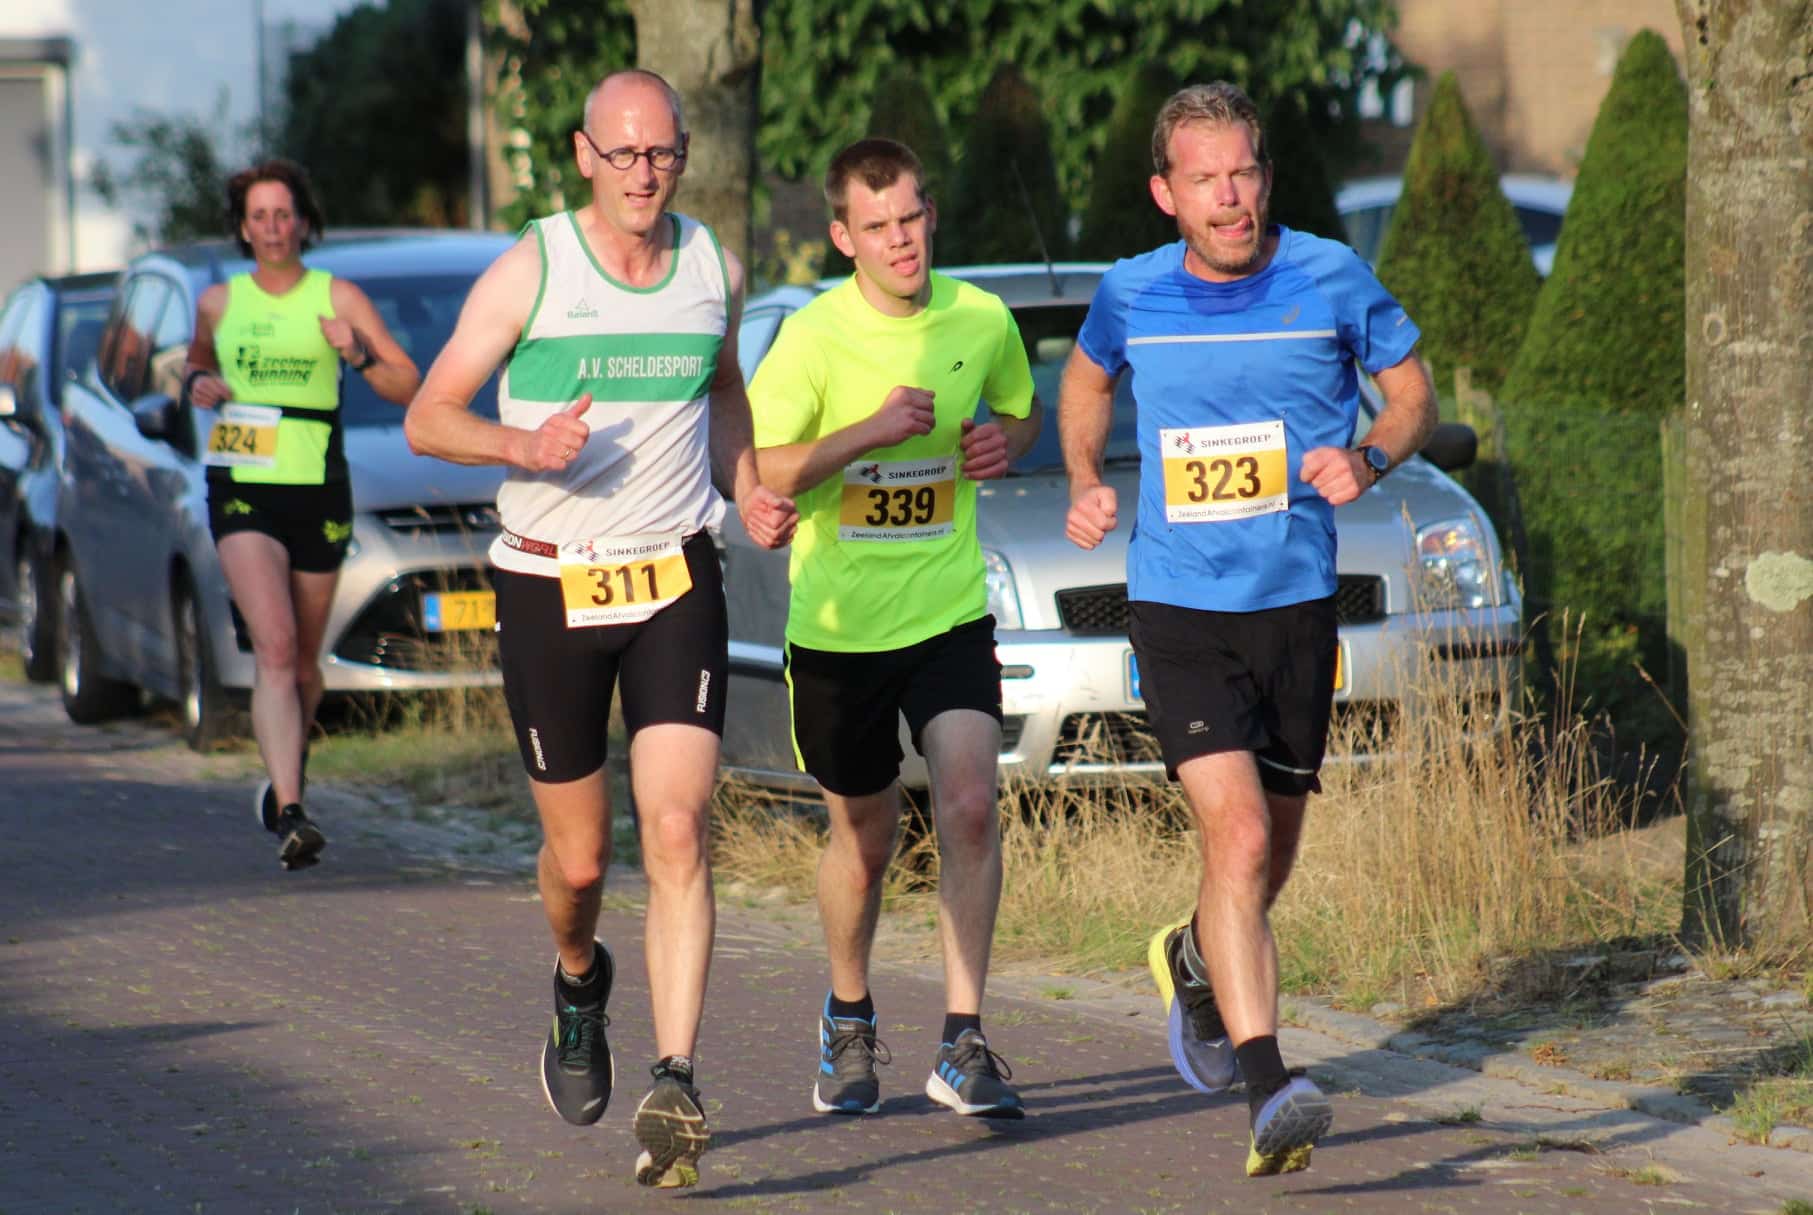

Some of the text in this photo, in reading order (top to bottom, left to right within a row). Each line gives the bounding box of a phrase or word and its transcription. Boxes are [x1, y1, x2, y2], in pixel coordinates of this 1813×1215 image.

[577, 354, 704, 379] A.V. SCHELDESPORT
[215, 424, 258, 453] 324
[1200, 433, 1272, 449] SINKEGROEP
[888, 466, 946, 480] SINKEGROEP
[1185, 456, 1262, 503] 323
[865, 486, 936, 527] 339
[606, 540, 671, 557] SINKEGROEP
[587, 562, 661, 606] 311
